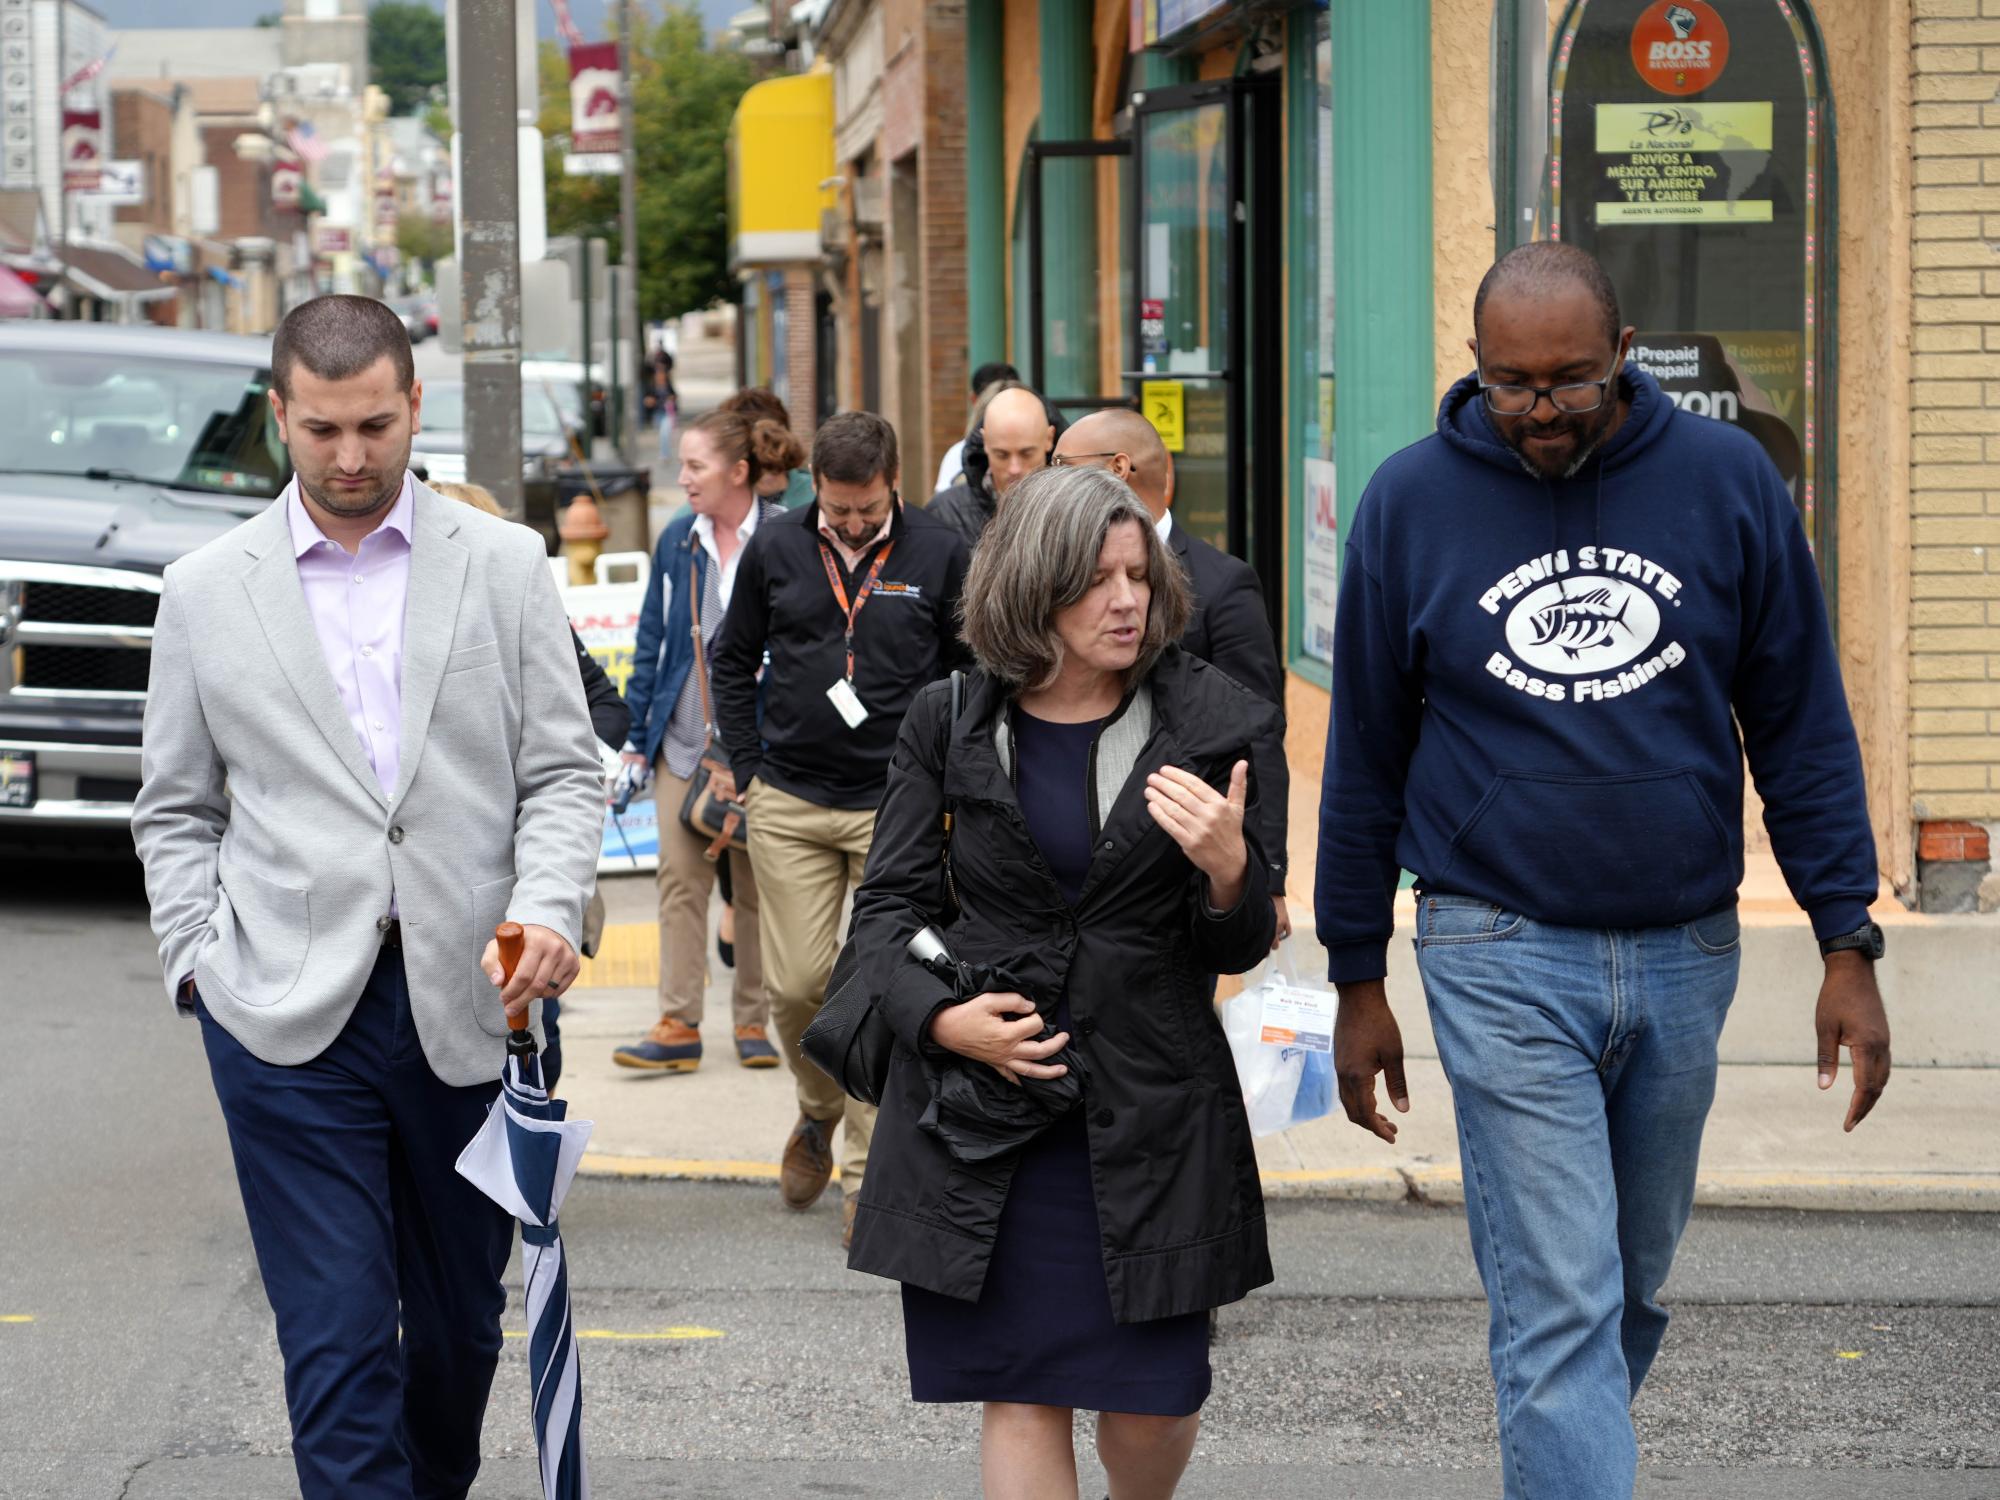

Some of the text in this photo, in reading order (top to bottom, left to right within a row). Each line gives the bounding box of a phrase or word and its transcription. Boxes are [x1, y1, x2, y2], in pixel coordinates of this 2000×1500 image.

[1648, 41, 1711, 60] BOSS
[1648, 59, 1711, 69] REVOLUTION
[1629, 139, 1694, 149] La Nacional
[1682, 153, 1693, 165] A
[1663, 165, 1717, 178] CENTRO,
[1619, 176, 1705, 189] SUR AMÉRICA
[1626, 190, 1699, 202] Y EL CARIBE
[1637, 345, 1699, 363] Prepaid
[1637, 362, 1699, 380] Prepaid
[1477, 545, 1683, 616] PENN STATE
[1484, 640, 1687, 703] Bass Fishing
